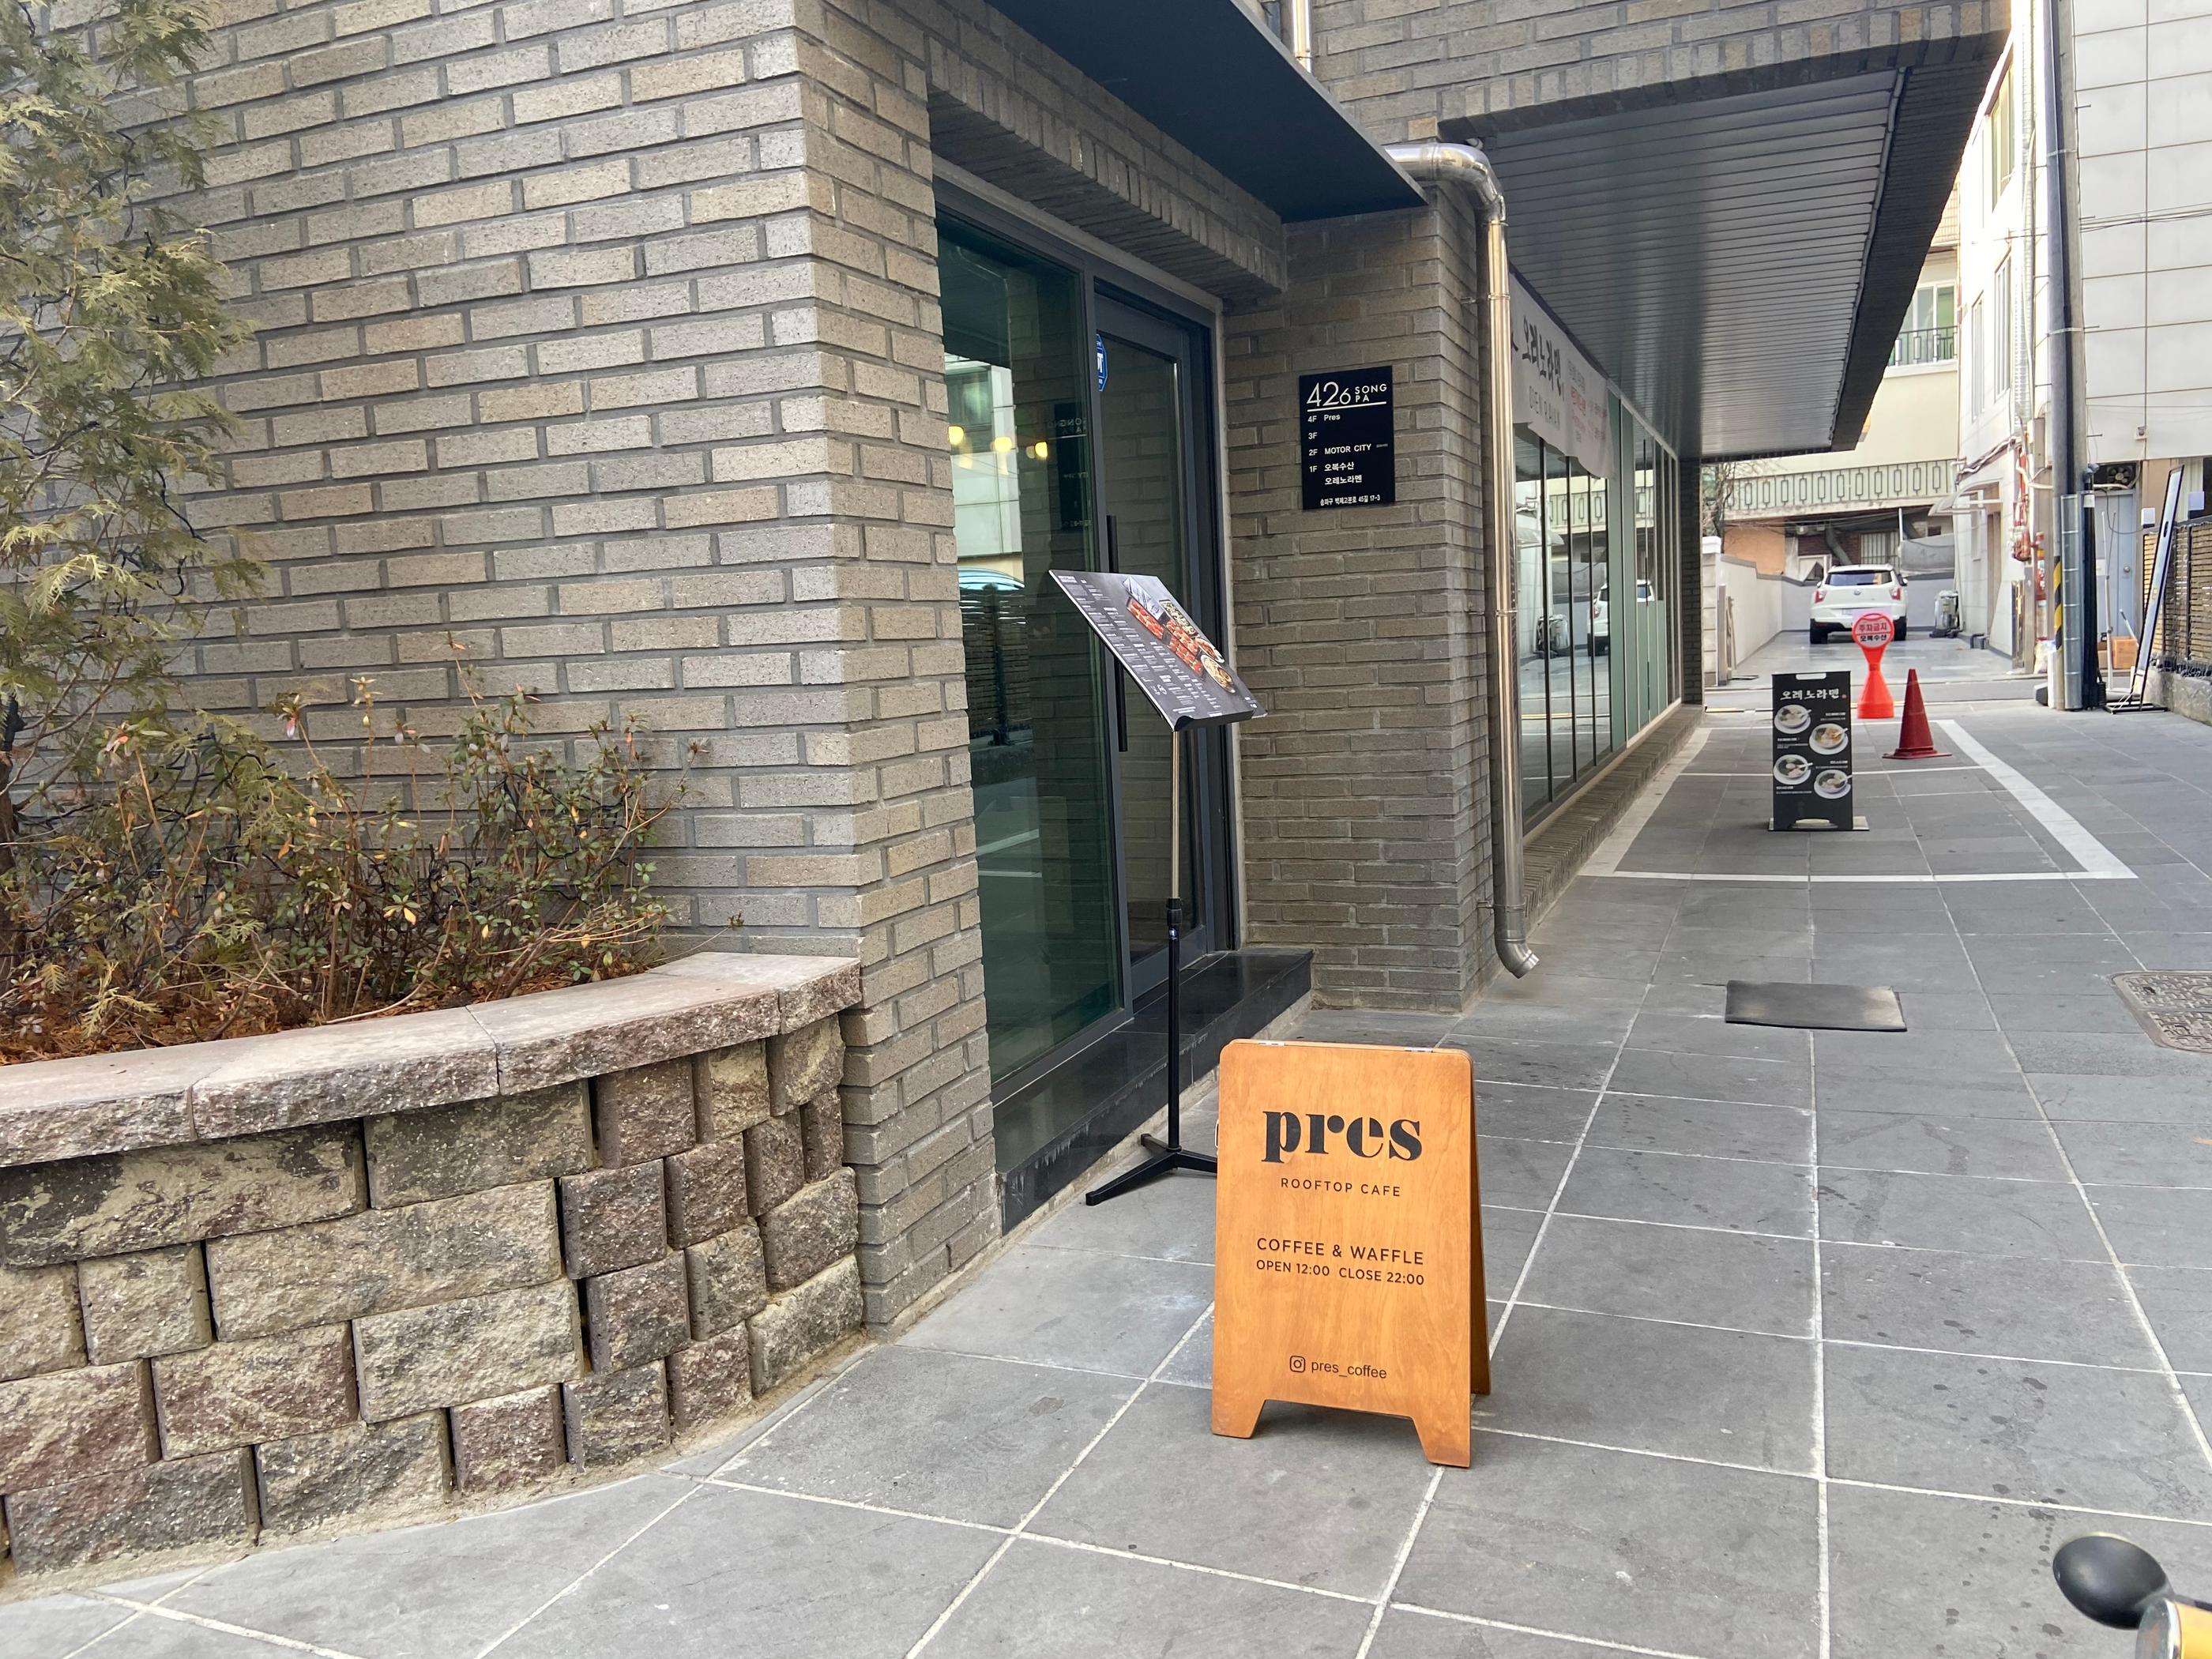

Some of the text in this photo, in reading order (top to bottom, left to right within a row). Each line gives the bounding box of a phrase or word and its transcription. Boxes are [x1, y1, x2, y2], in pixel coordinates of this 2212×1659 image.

[1307, 382, 1386, 407] 426 SONG
[1325, 475, 1362, 484] 오레노라멘
[1780, 688, 1839, 701] 오레노라멘
[1262, 1112, 1421, 1163] pres
[1281, 1178, 1399, 1196] ROOFTOP CAFE
[1258, 1238, 1423, 1265] COFFEE & WAFFLE
[1257, 1260, 1424, 1285] OPEN 12:00 CLOSE 22:00
[1312, 1362, 1386, 1379] pres_coffee
